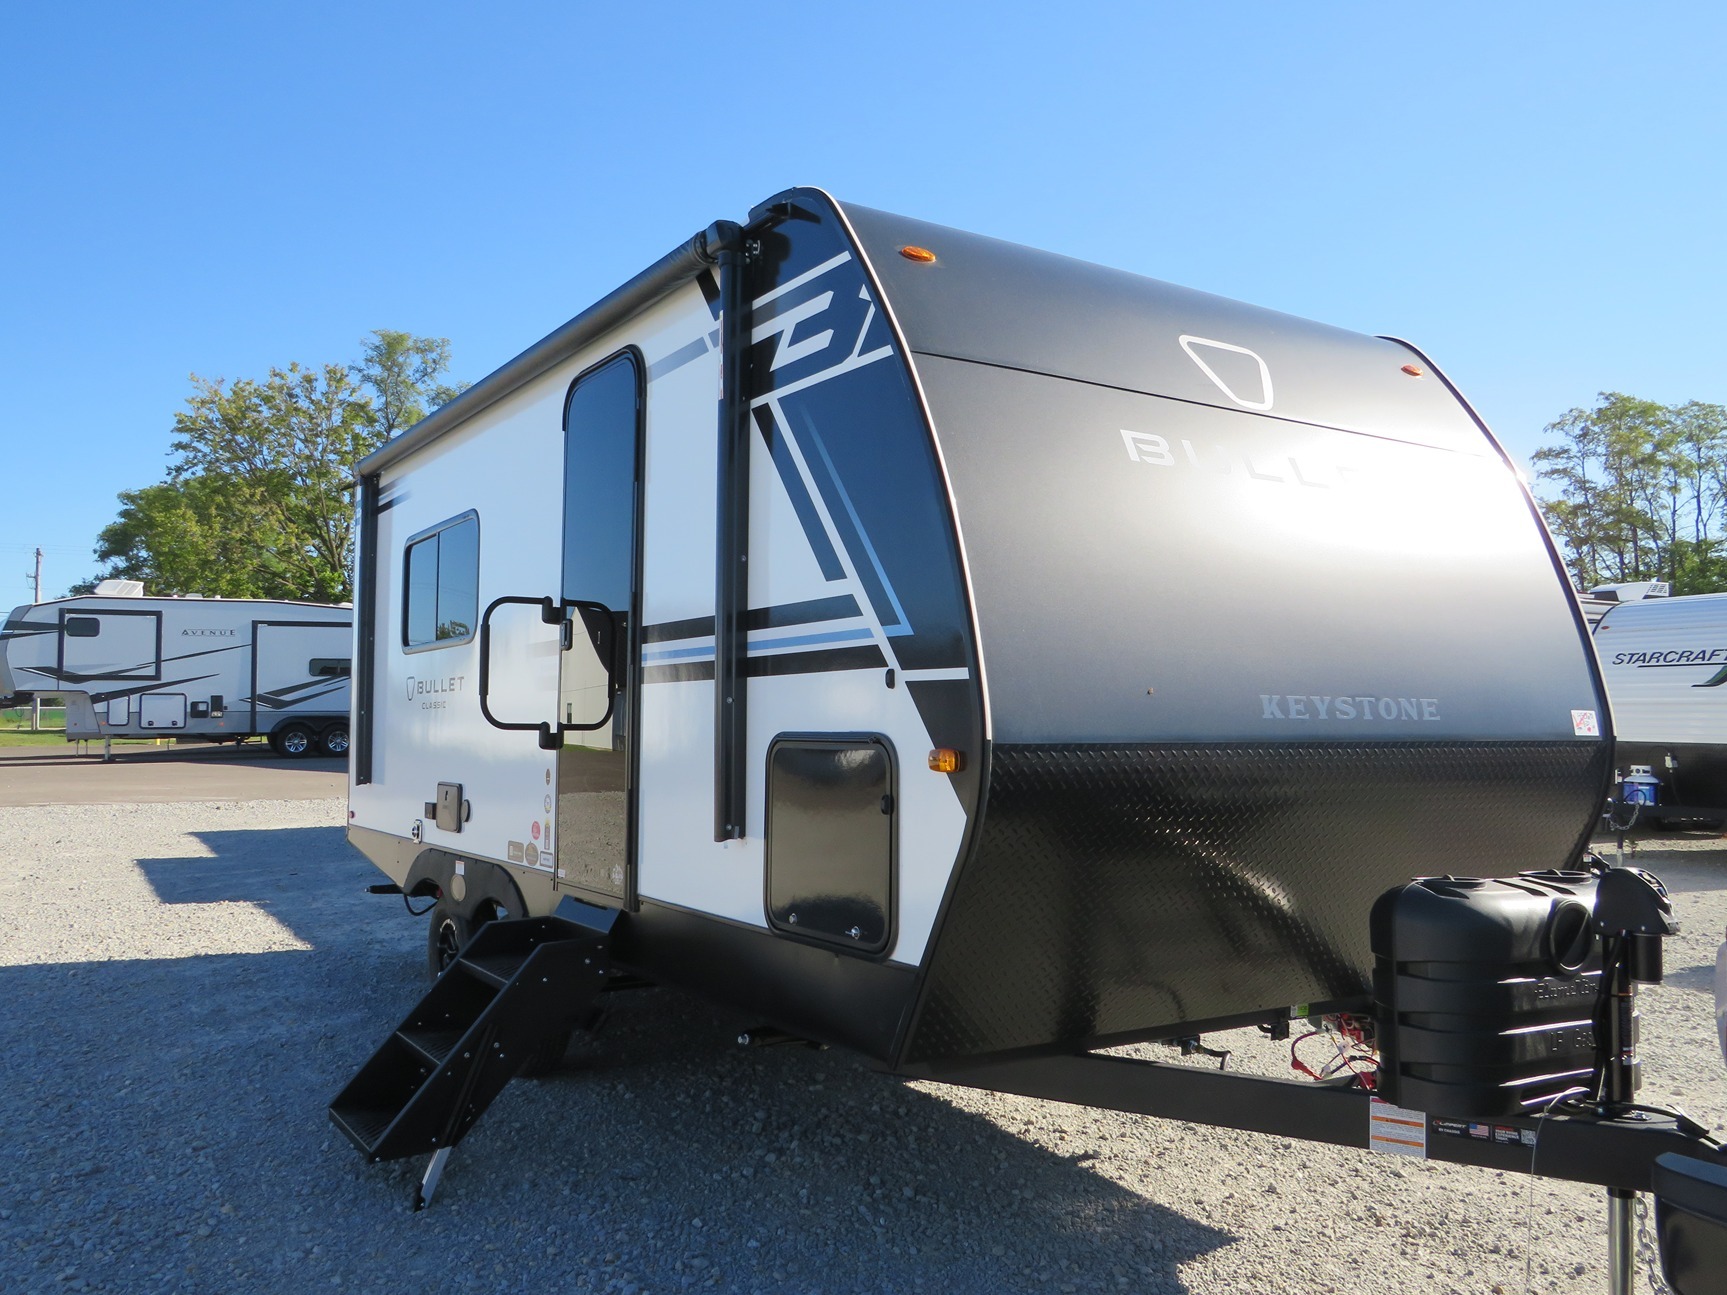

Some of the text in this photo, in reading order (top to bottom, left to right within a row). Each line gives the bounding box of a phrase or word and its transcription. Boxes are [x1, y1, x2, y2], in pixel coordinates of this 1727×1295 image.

[416, 676, 464, 694] BULLET
[421, 701, 446, 710] CLASSIC
[1259, 694, 1441, 721] KEYSTONE
